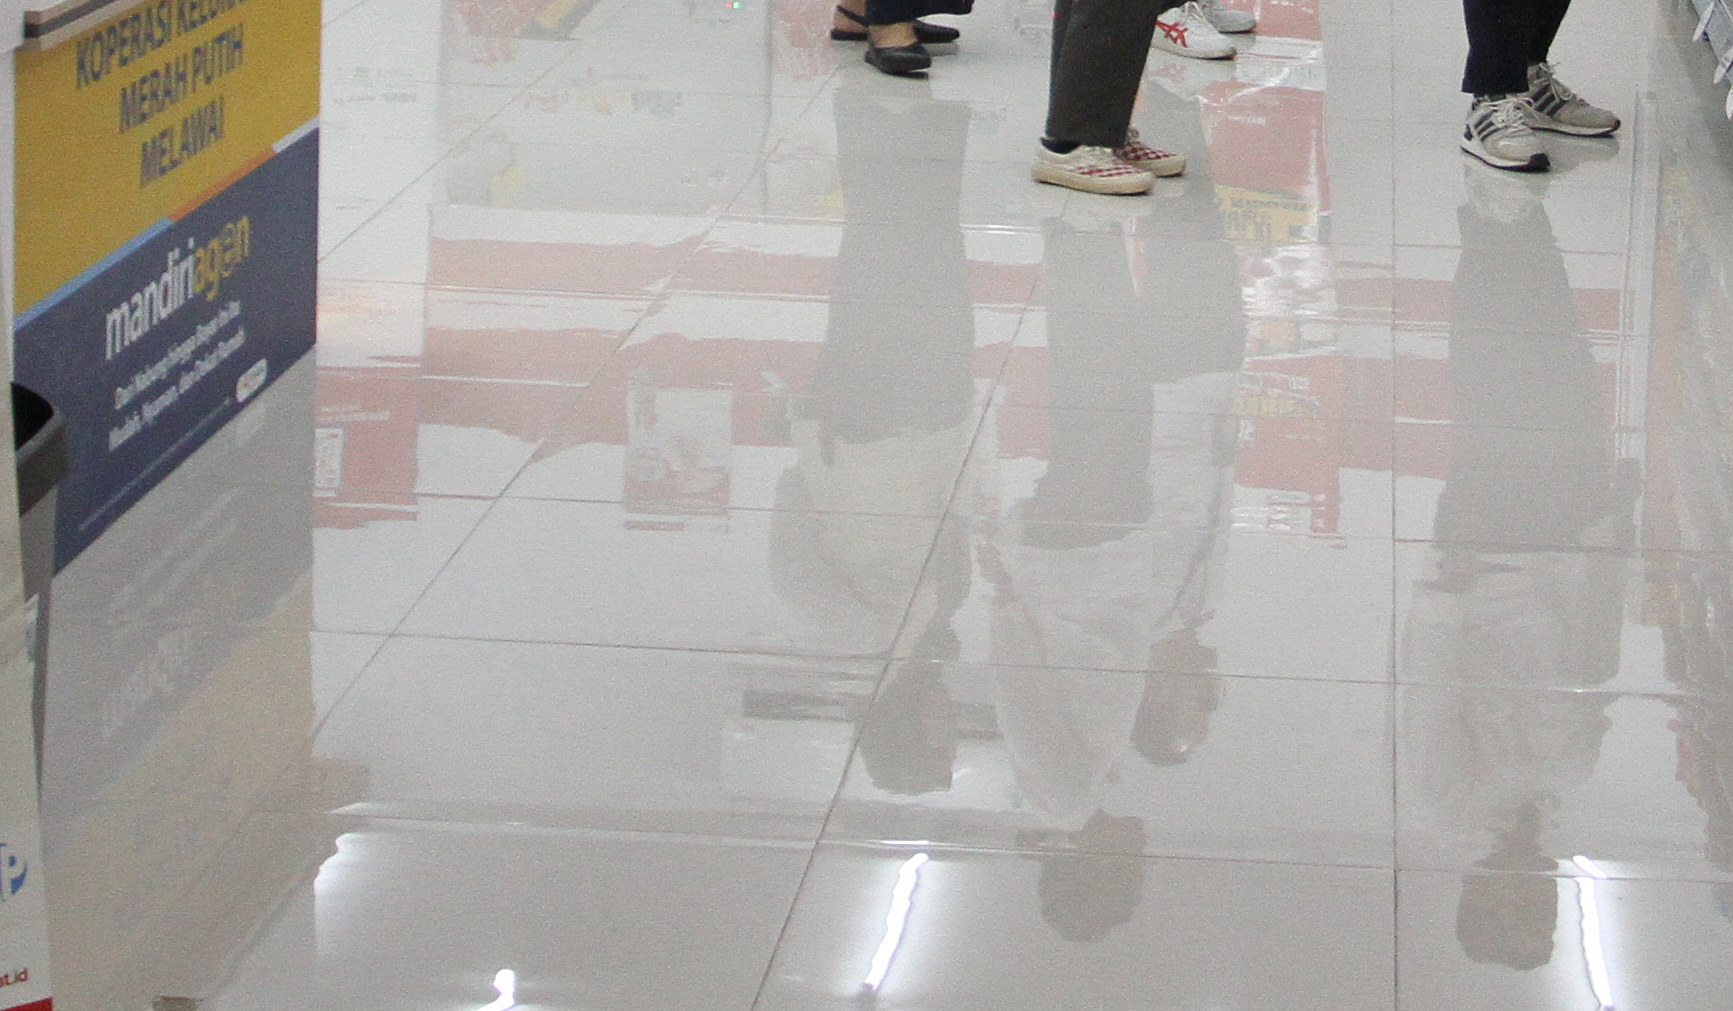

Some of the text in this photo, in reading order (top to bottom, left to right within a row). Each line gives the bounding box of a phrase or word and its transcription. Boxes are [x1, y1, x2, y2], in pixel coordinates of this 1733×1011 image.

[119, 22, 245, 135] MERAH PUTIH
[140, 94, 225, 188] MELAWAI
